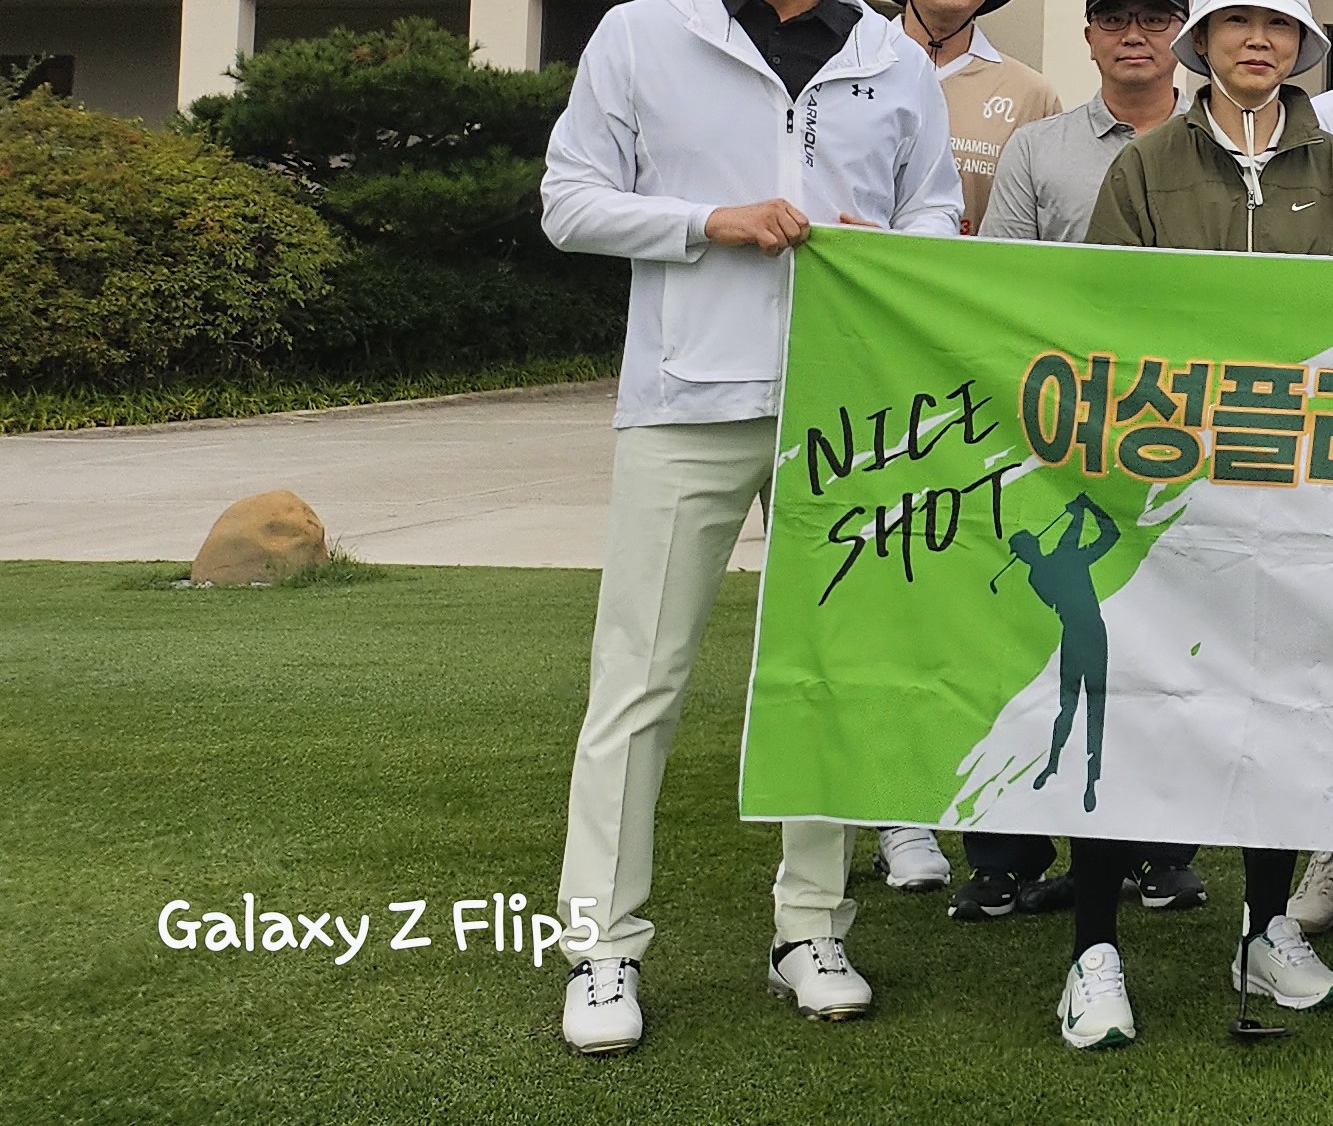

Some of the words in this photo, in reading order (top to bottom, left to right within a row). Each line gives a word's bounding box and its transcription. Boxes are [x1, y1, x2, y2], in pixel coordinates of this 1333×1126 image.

[803, 93, 818, 168] ARMOUR
[953, 157, 961, 171] S
[804, 379, 1000, 496] NICE
[817, 462, 1022, 606] SHOT
